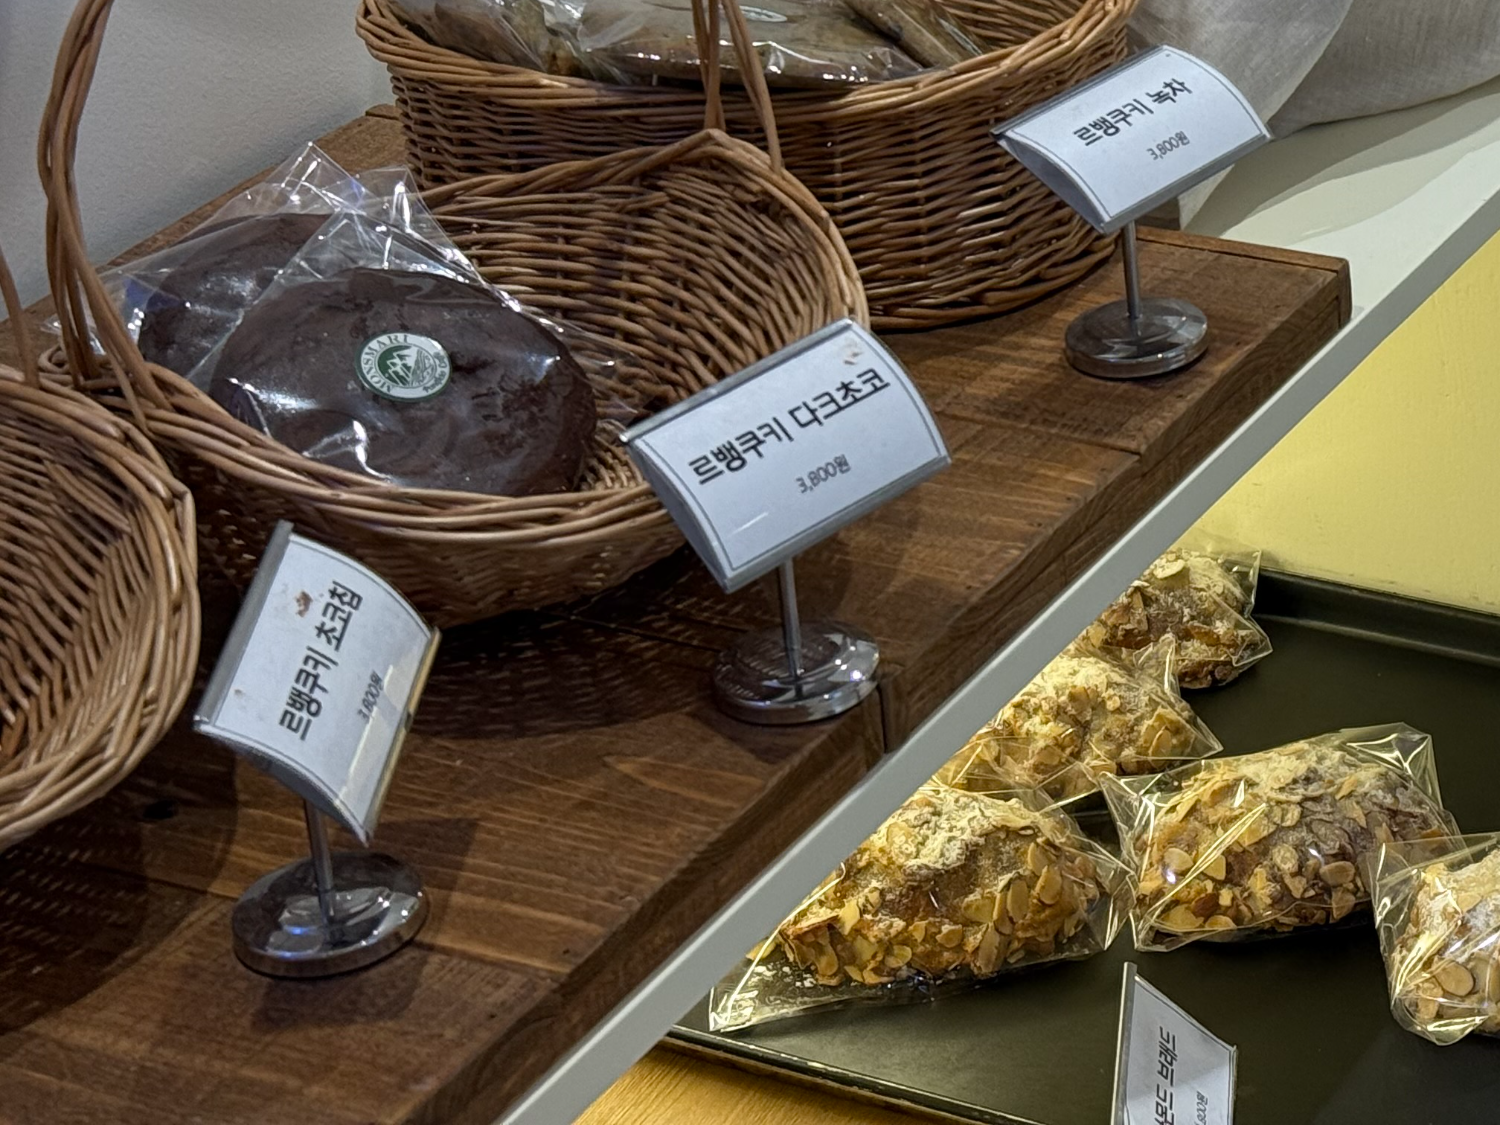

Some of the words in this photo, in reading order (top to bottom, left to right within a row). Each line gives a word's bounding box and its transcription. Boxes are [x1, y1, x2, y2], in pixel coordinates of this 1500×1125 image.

[1073, 98, 1154, 147] 르뱅쿠키
[1145, 78, 1193, 104] 녹차
[1146, 130, 1191, 161] 3,800원
[362, 334, 408, 393] MONSMARI
[688, 417, 795, 486] 르뱅쿠키
[788, 368, 891, 429] 다크초코
[795, 454, 852, 494] 3,800원
[278, 644, 340, 742] 르뱅쿠키
[315, 579, 364, 653] 초코칩
[358, 670, 384, 722] 3800원
[1157, 1025, 1178, 1088] 브래드
[1154, 1083, 1175, 1125] 몬드
